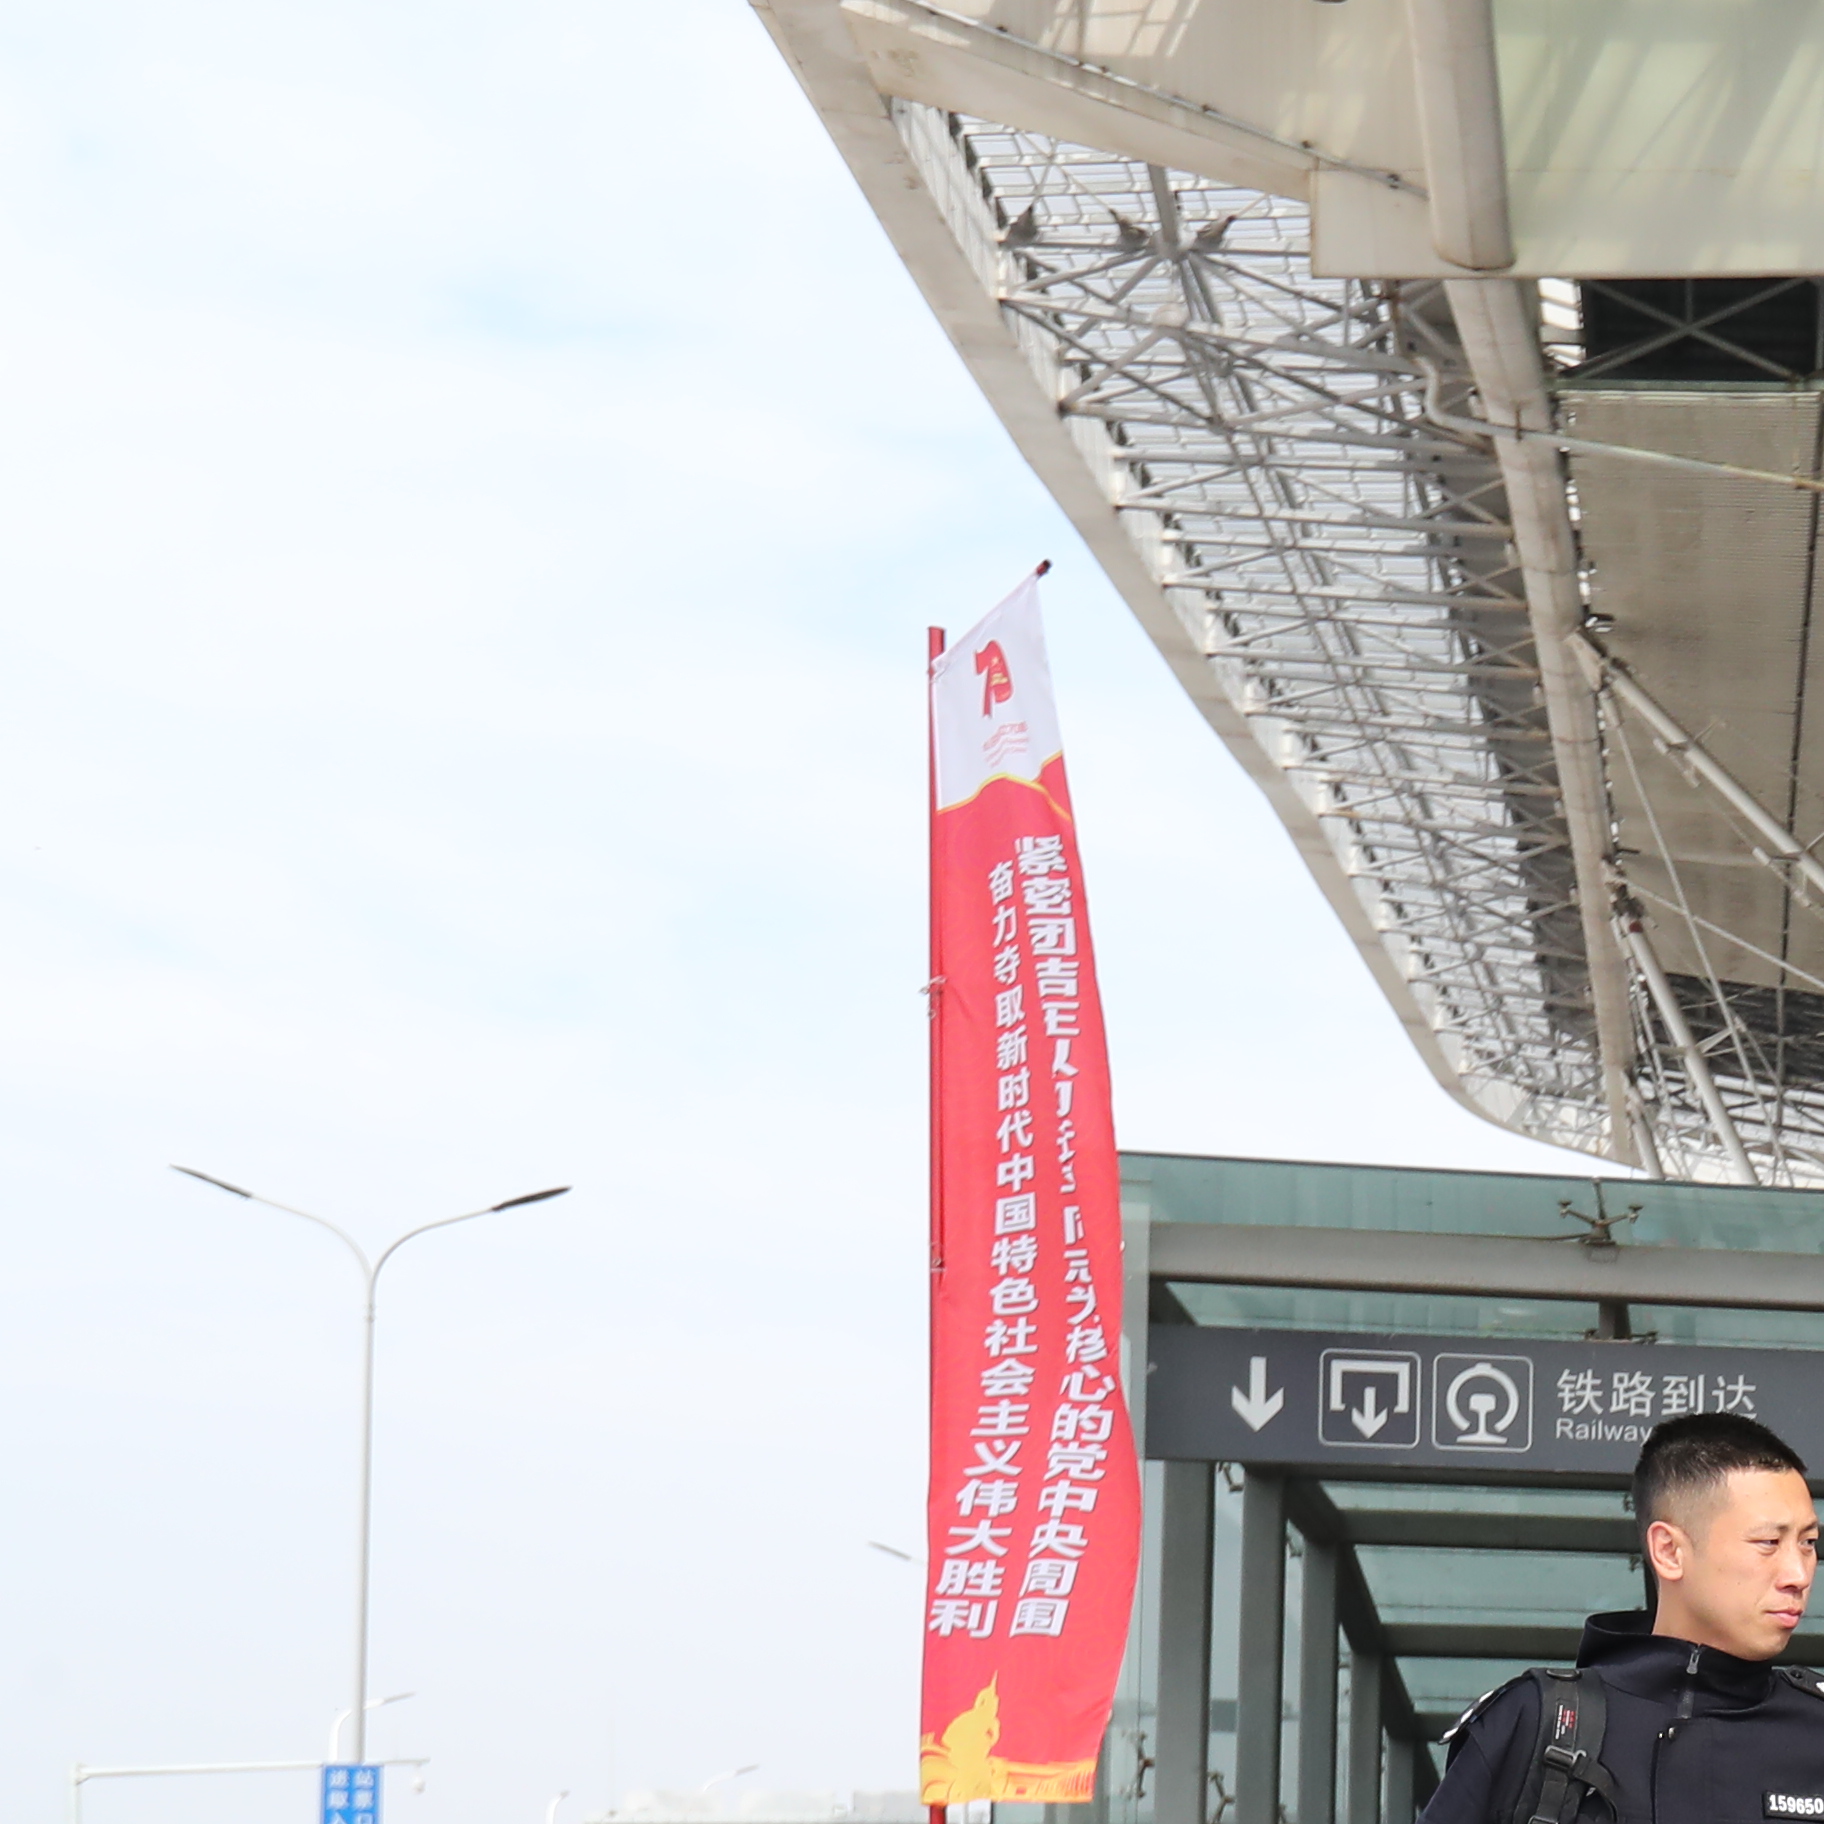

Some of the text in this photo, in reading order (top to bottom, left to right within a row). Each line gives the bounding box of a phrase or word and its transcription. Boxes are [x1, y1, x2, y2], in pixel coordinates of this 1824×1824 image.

[928, 860, 1040, 1639] 奋力夺取新时代中国特色社会主义伟大胜利
[1556, 1369, 1757, 1419] 铁路到达
[1555, 1418, 1652, 1447] Railway
[1769, 1794, 1824, 1815] 159650
